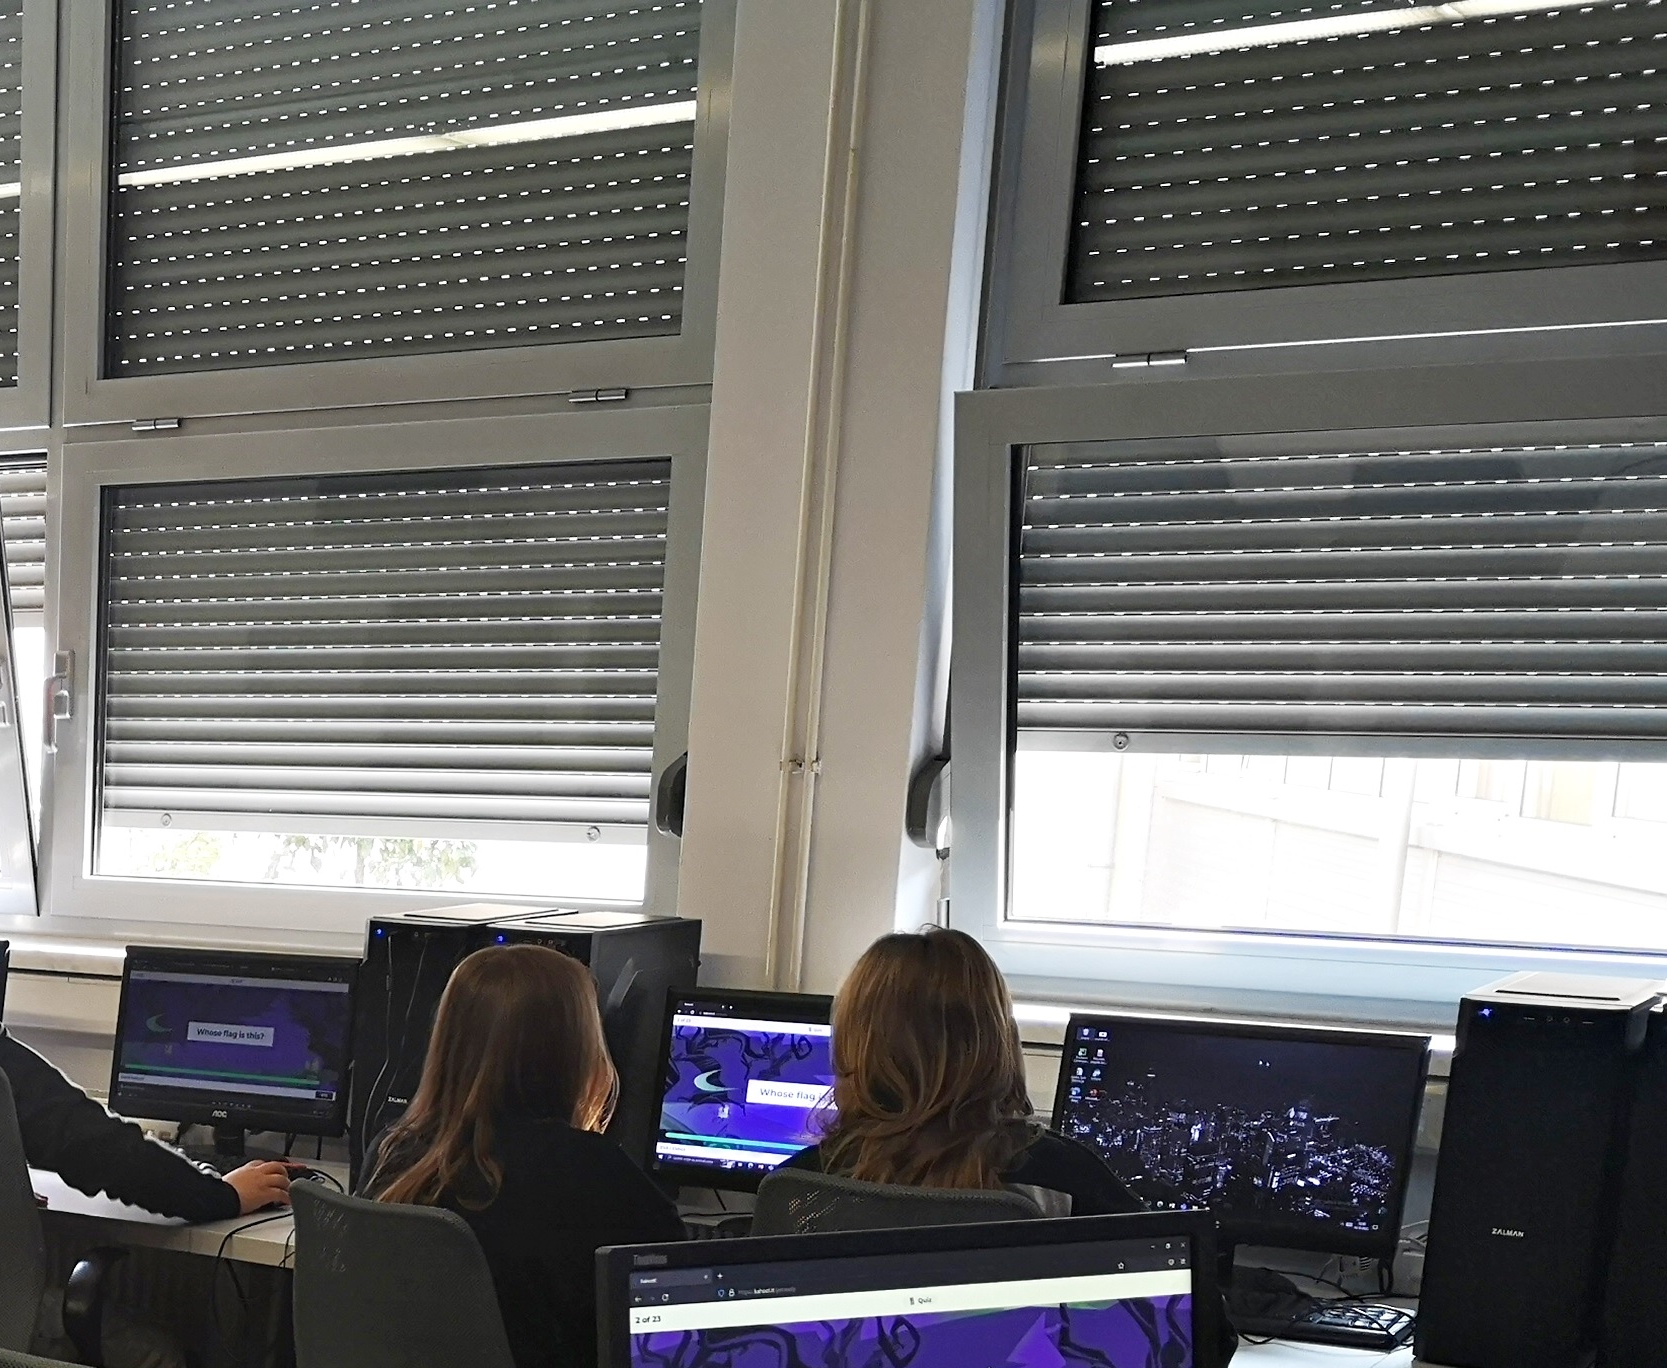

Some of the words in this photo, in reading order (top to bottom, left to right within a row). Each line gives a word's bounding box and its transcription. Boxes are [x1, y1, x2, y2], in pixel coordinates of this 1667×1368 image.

[197, 1028, 222, 1037] Whose
[223, 1029, 238, 1040] flag
[760, 1088, 794, 1099] Whose
[796, 1090, 816, 1102] flag
[1491, 1228, 1524, 1238] ZALMAN
[642, 1315, 651, 1323] of
[652, 1315, 662, 1323] 23
